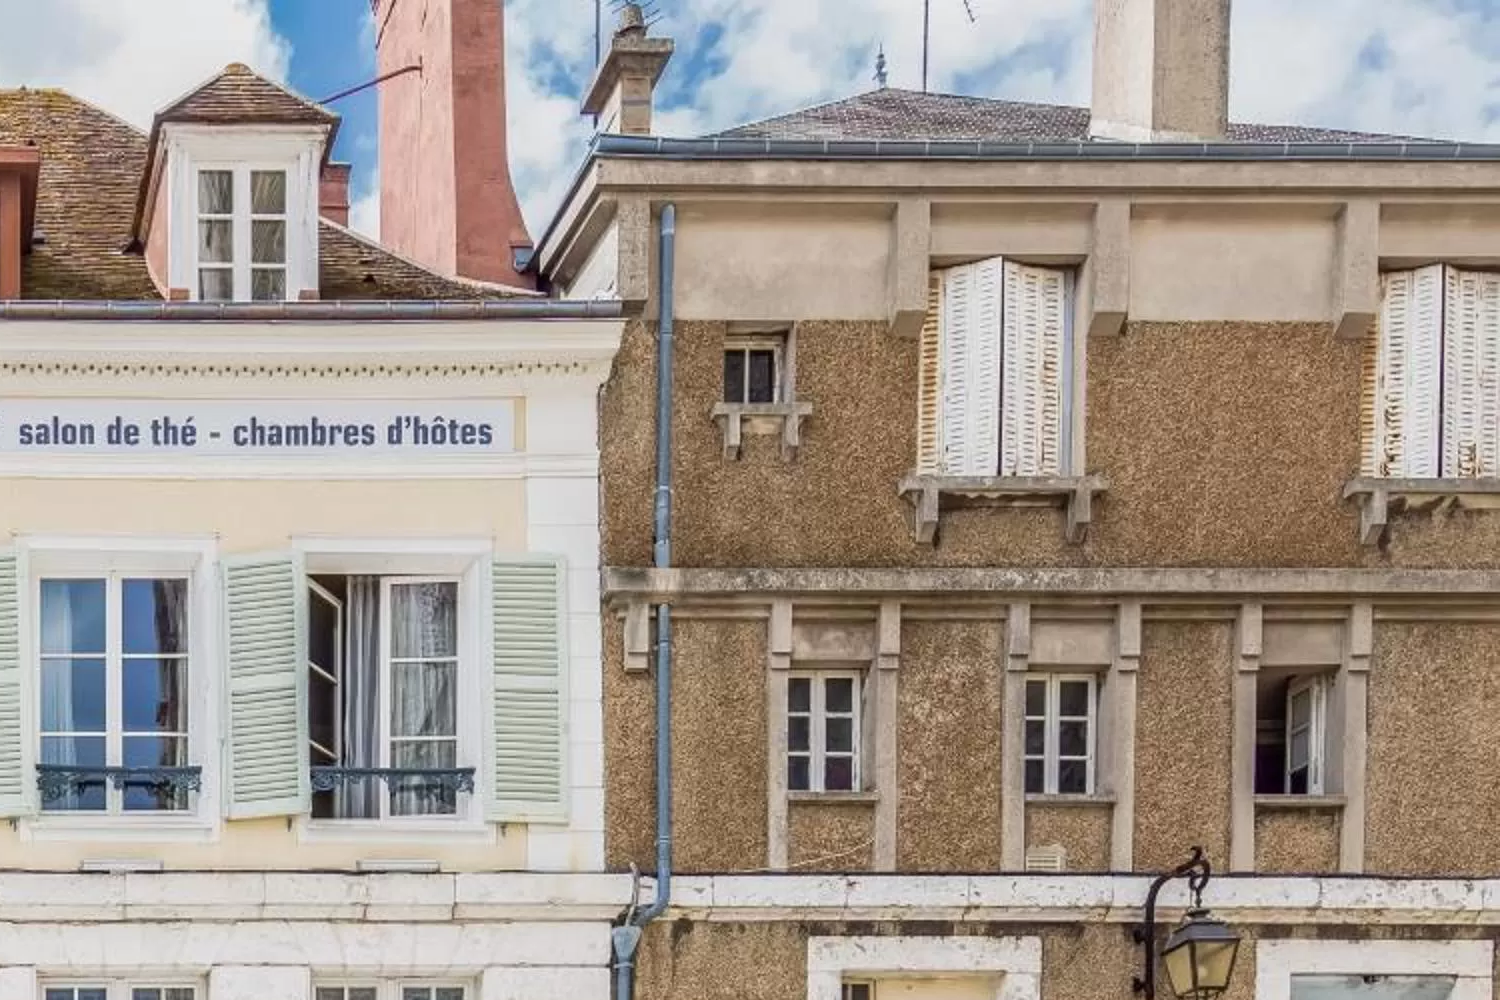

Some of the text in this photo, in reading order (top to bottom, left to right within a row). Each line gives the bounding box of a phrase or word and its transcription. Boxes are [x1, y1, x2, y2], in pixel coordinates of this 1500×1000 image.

[18, 416, 95, 446] salon
[106, 416, 140, 446] de
[150, 416, 197, 447] thé
[232, 416, 376, 447] chambres
[387, 415, 493, 446] d'hôtes
